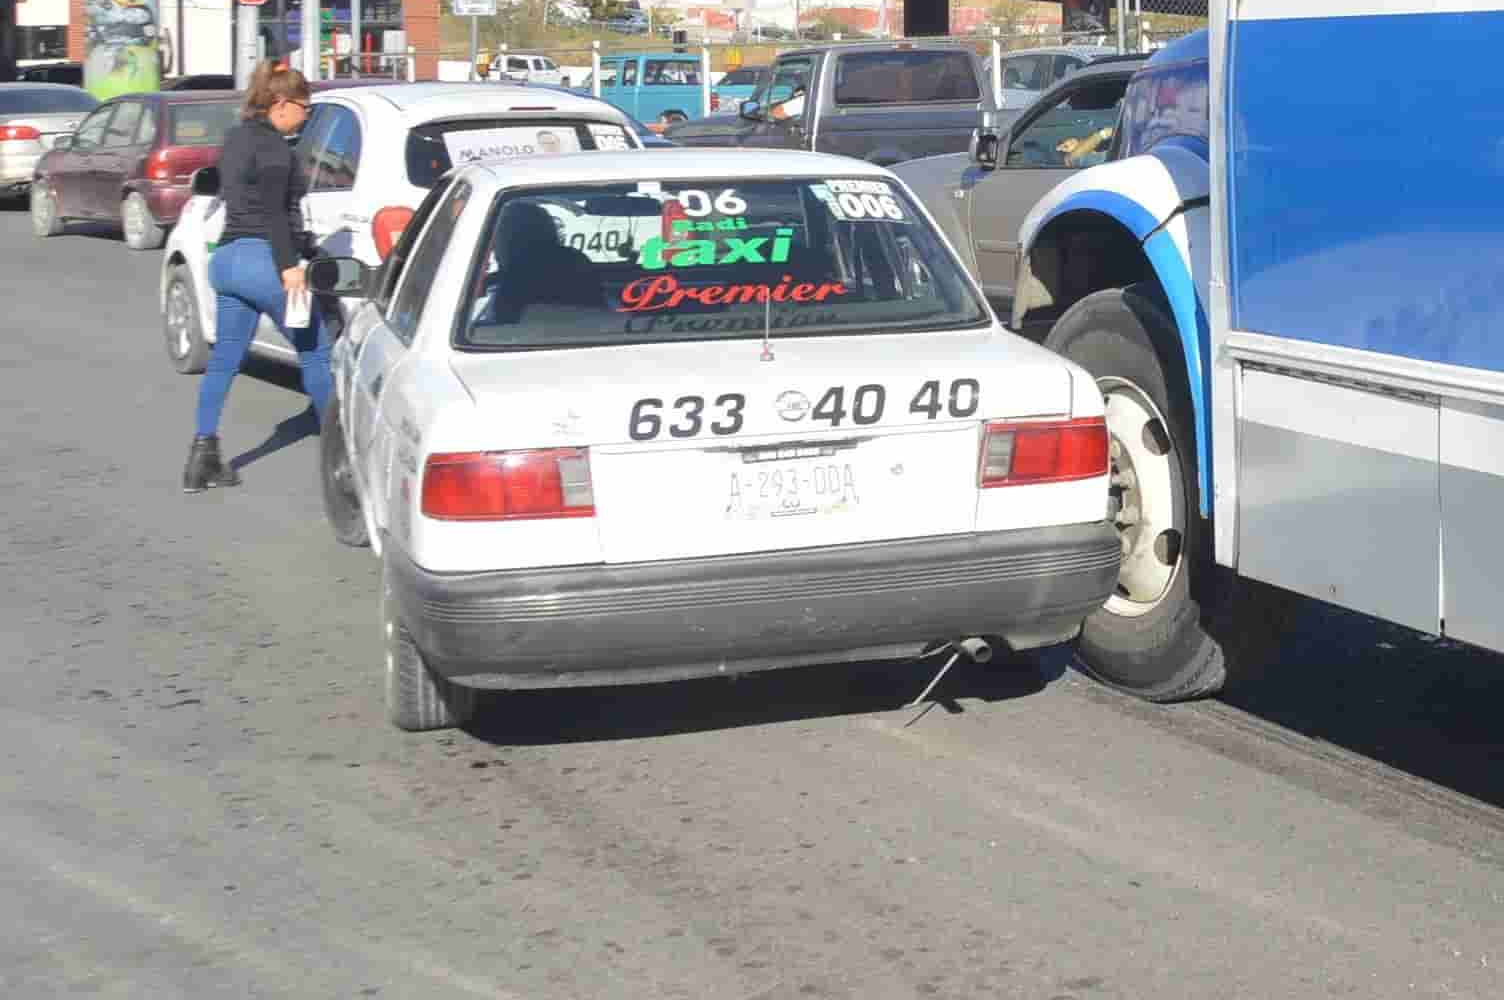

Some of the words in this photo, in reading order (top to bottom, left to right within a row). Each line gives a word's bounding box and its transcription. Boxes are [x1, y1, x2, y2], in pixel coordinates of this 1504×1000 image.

[838, 193, 903, 219] 006
[640, 228, 794, 269] taxi
[616, 273, 849, 312] Premier
[628, 394, 746, 441] 633
[811, 383, 886, 427] 40
[908, 377, 980, 419] 40
